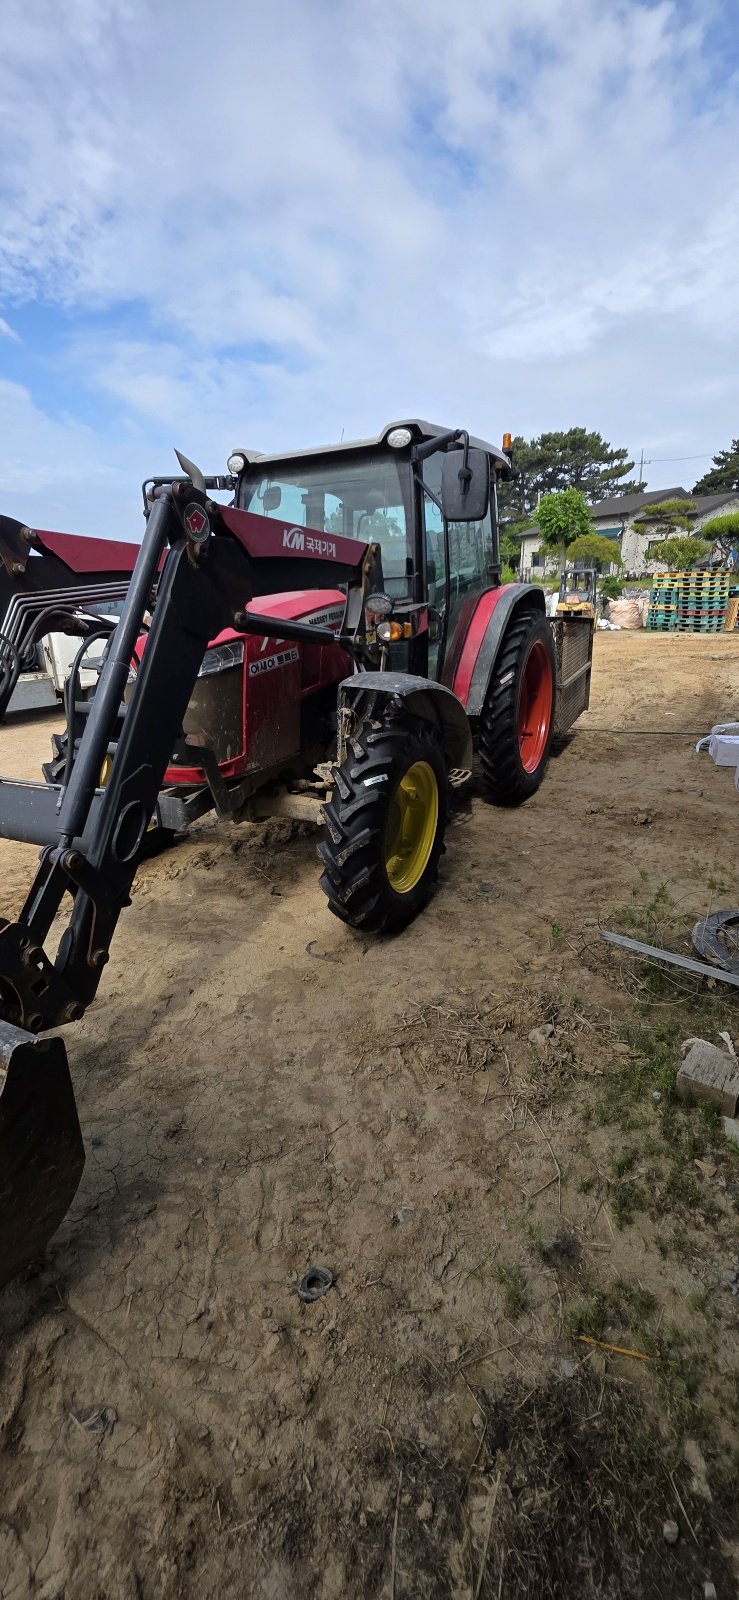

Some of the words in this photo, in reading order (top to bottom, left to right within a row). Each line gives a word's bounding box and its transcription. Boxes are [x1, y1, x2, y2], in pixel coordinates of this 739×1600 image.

[282, 527, 304, 551] KM
[306, 537, 336, 558] 국제기계
[308, 613, 328, 625] MASSEY
